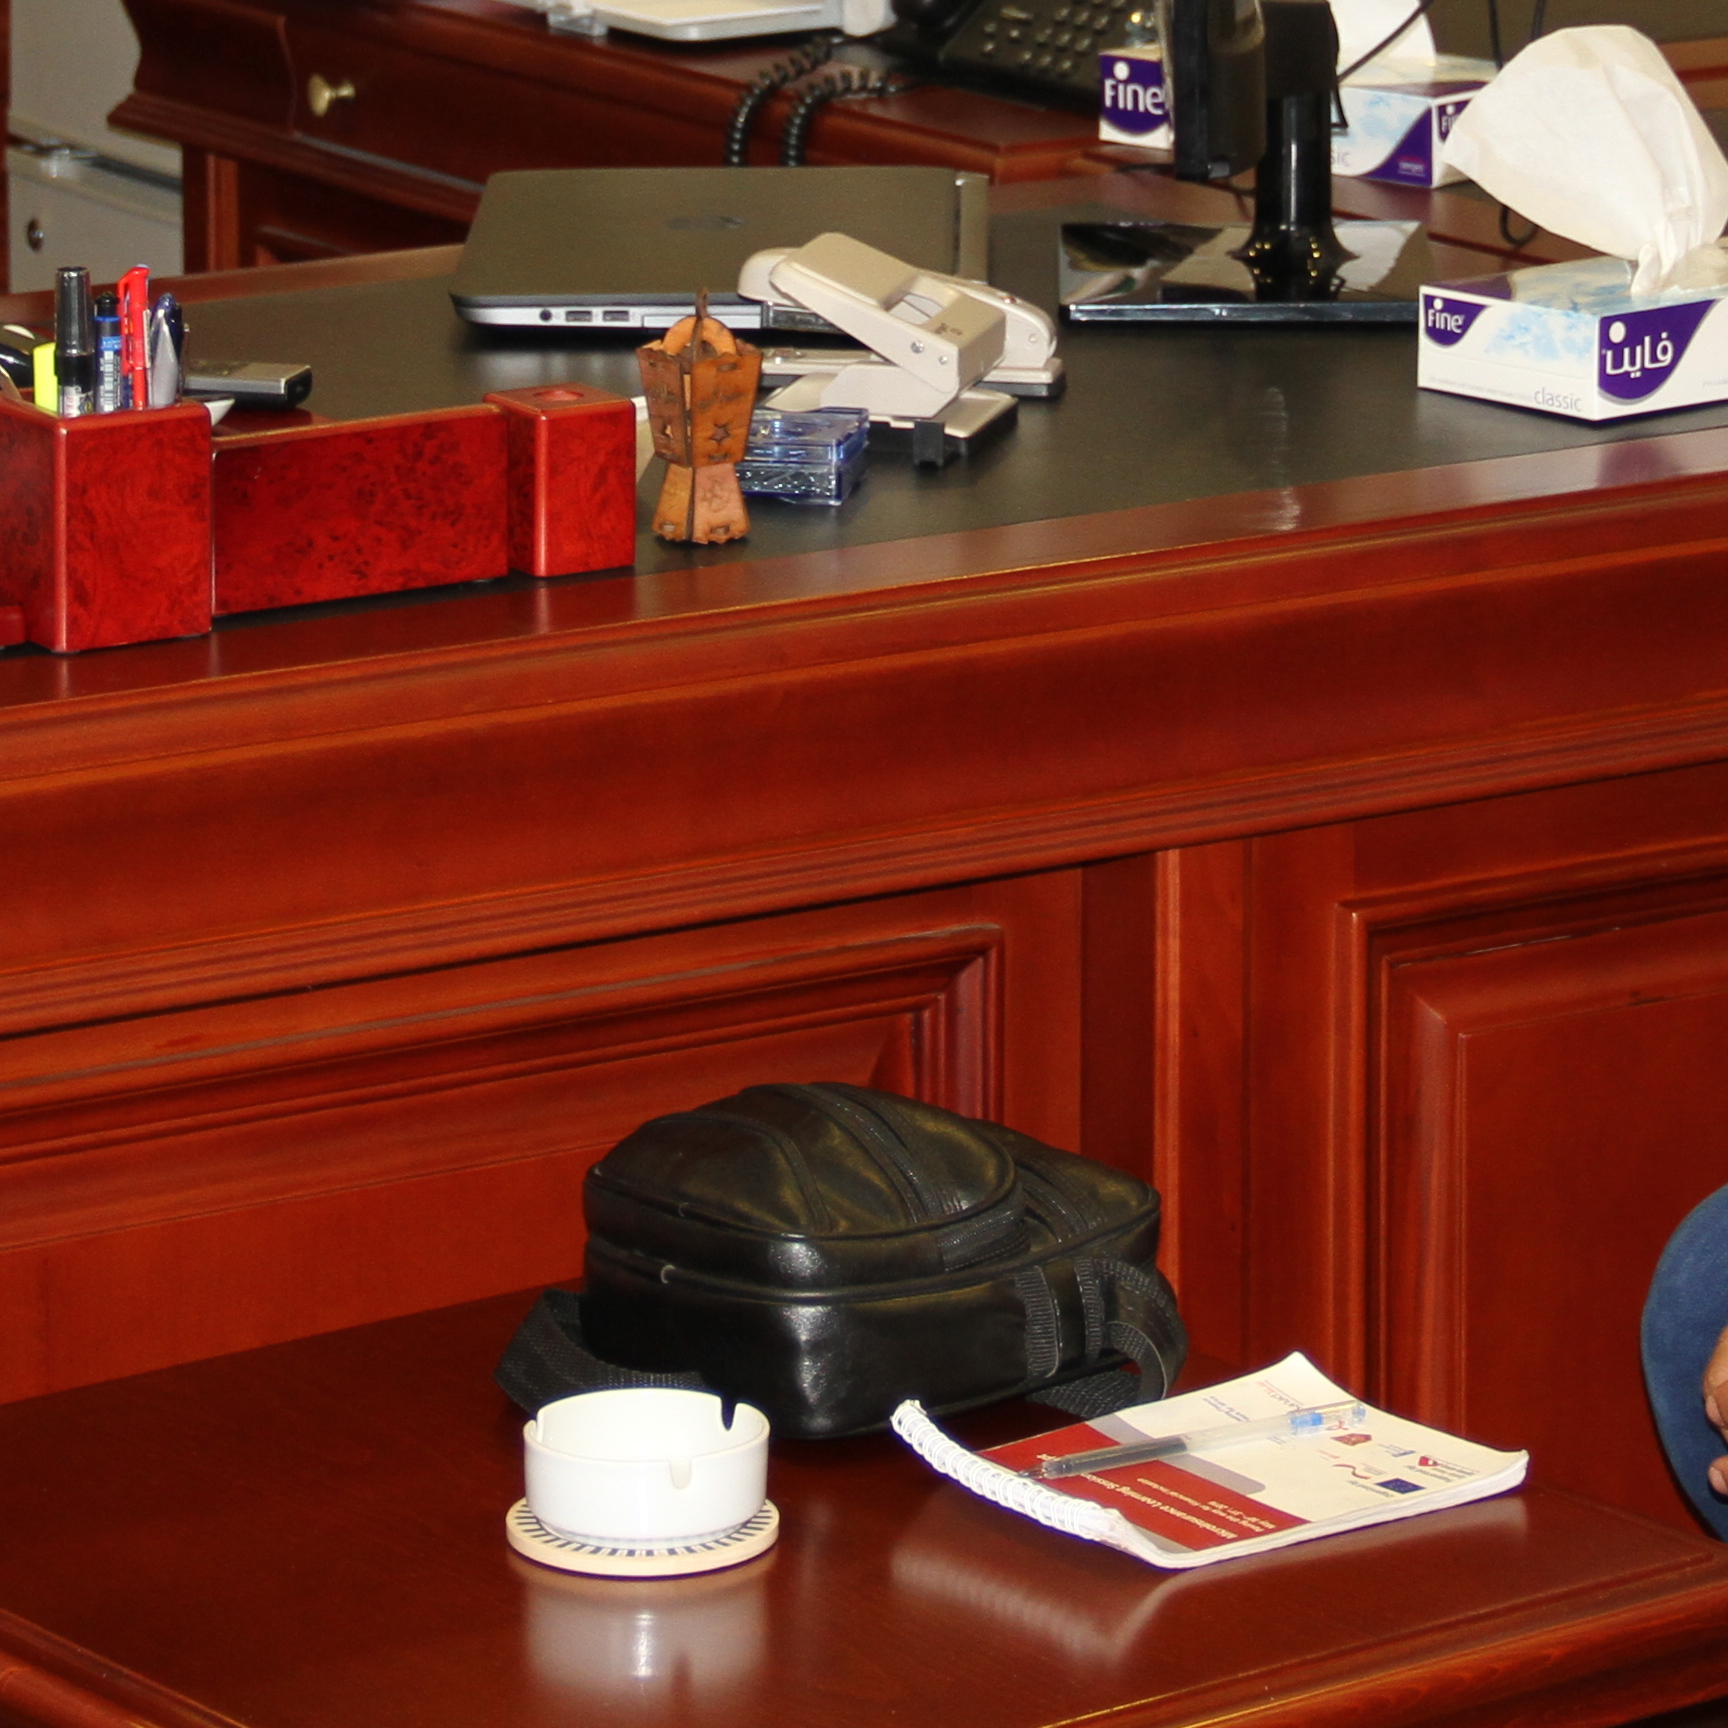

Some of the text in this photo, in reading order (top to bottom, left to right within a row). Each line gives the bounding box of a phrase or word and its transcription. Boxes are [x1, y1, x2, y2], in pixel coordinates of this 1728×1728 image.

[1103, 61, 1167, 115] Fine
[1427, 298, 1463, 334] Fine
[1604, 320, 1675, 379] فاين
[1533, 387, 1583, 413] classic
[1116, 1486, 1162, 1508] Learning
